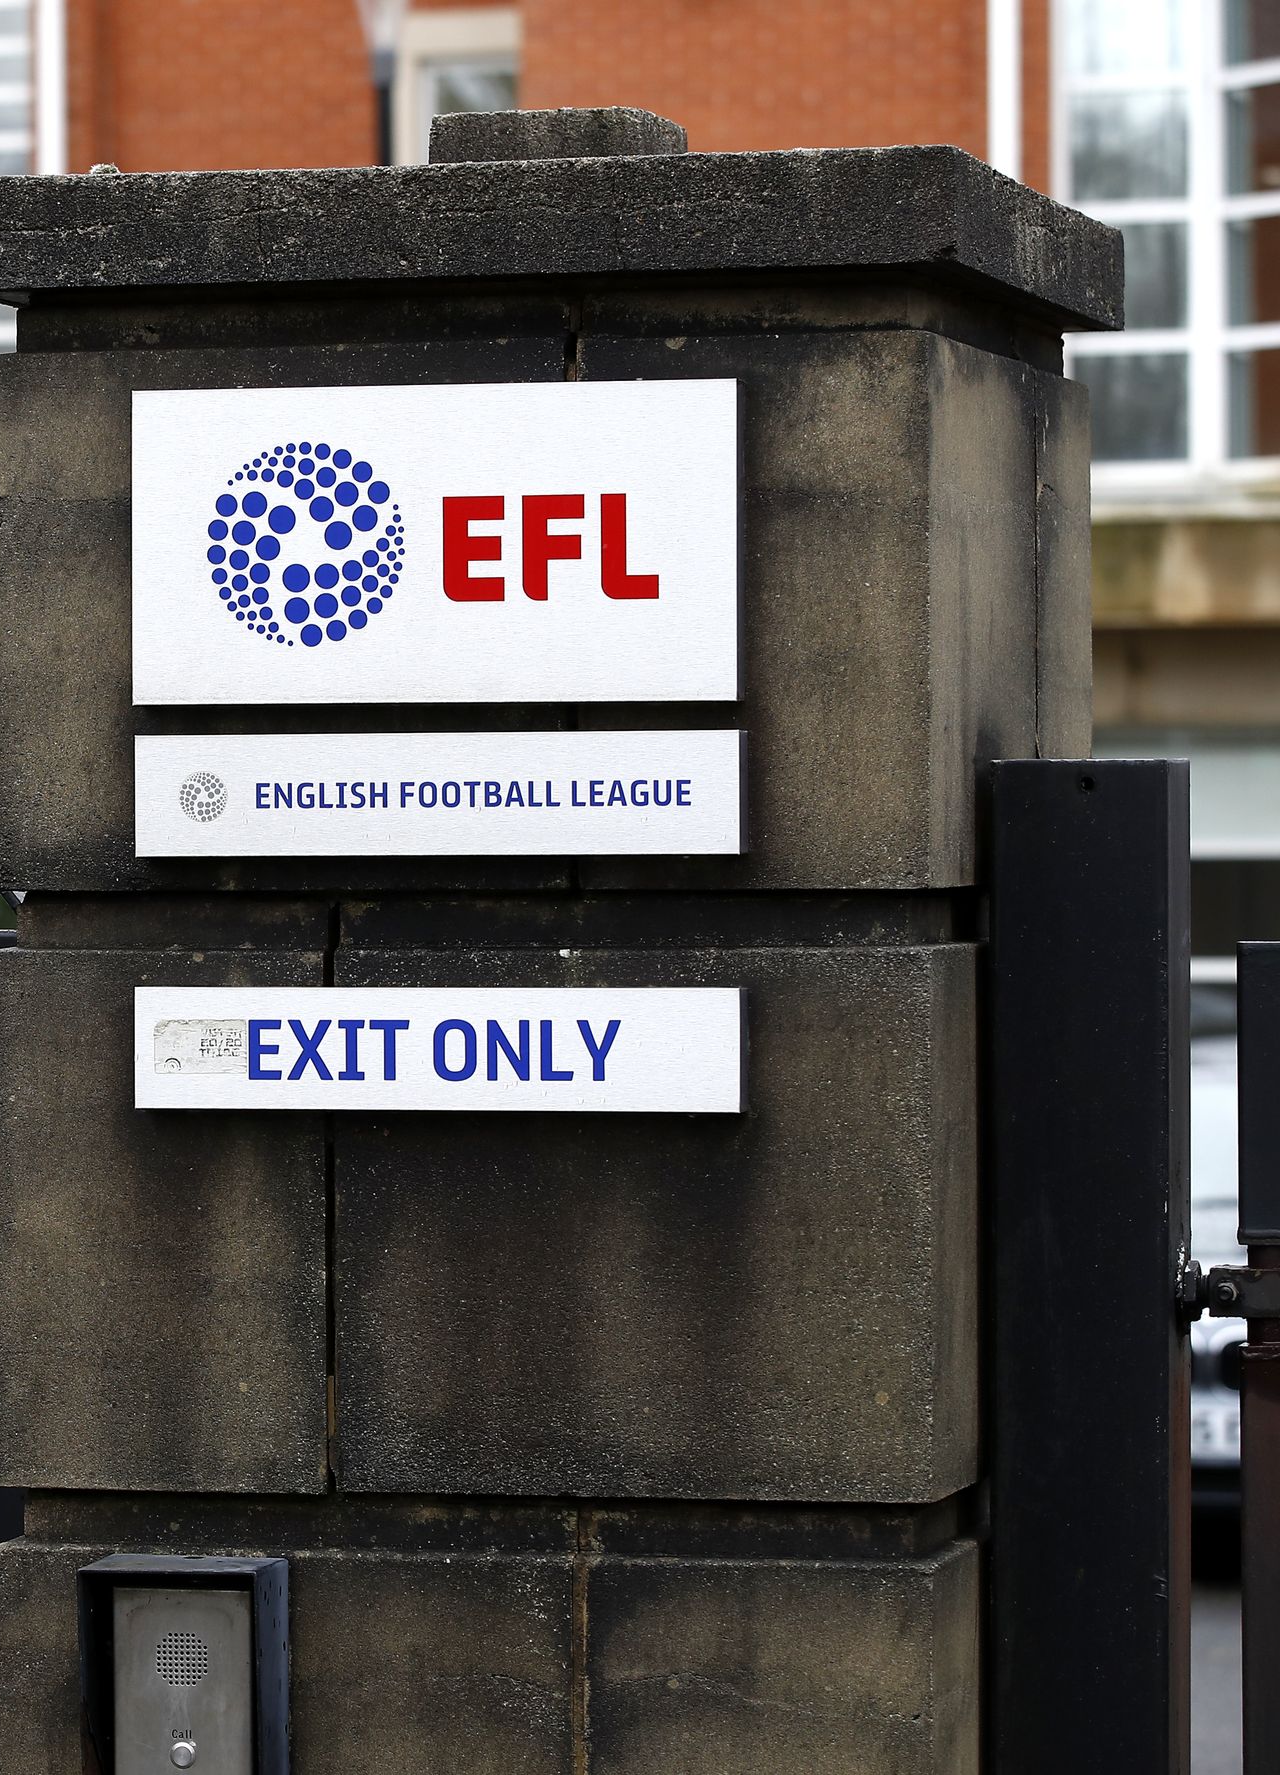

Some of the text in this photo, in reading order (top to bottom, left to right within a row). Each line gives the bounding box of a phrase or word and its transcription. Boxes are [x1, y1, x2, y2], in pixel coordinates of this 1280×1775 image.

[442, 493, 660, 603] EFL
[255, 779, 692, 810] ENGLISH FOOTBALL LEAGUE
[247, 1018, 623, 1082] EXIT ONLY
[171, 1729, 192, 1739] Call
